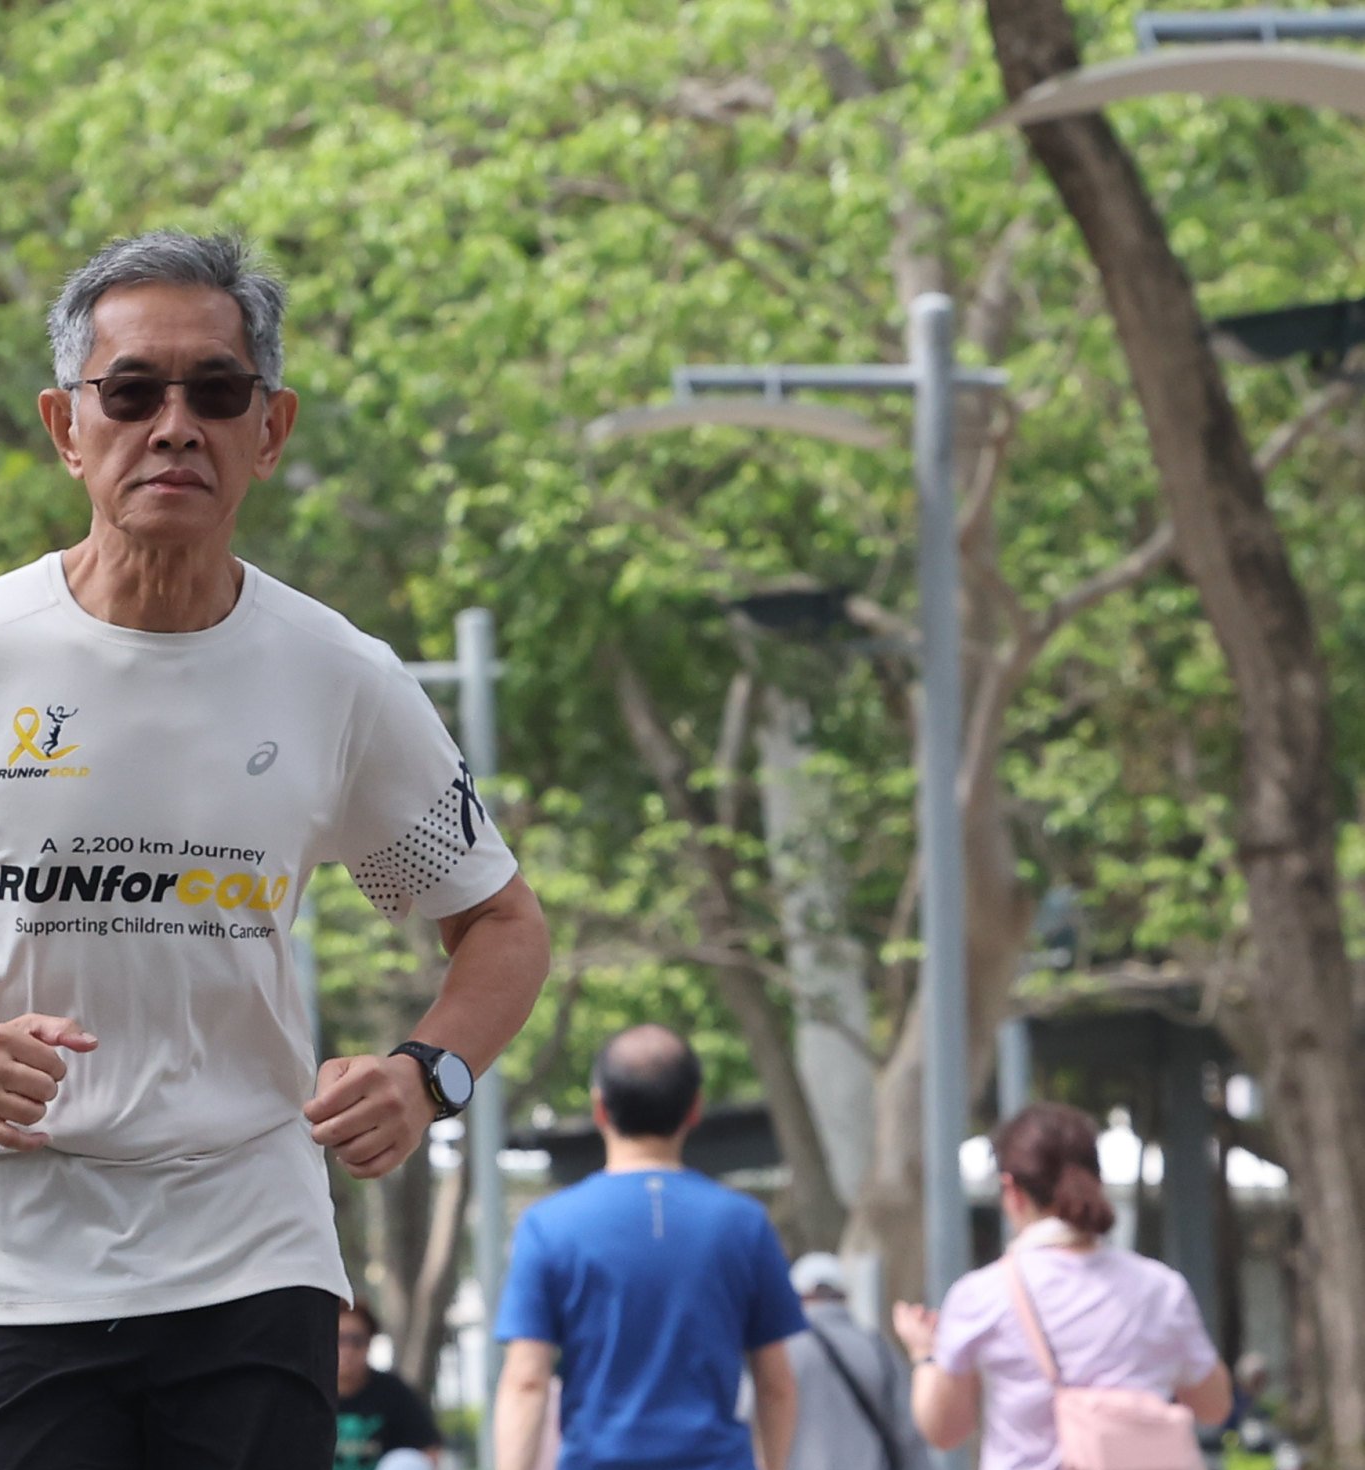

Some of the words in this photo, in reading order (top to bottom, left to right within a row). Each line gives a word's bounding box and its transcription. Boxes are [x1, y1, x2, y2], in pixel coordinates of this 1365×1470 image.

[40, 838, 58, 854] A
[71, 837, 134, 856] 2,200
[139, 837, 173, 855] km
[178, 840, 266, 865] Journey
[15, 916, 108, 936] Supporting
[111, 917, 184, 935] Children
[188, 920, 226, 938] with
[229, 923, 276, 940] Cancer
